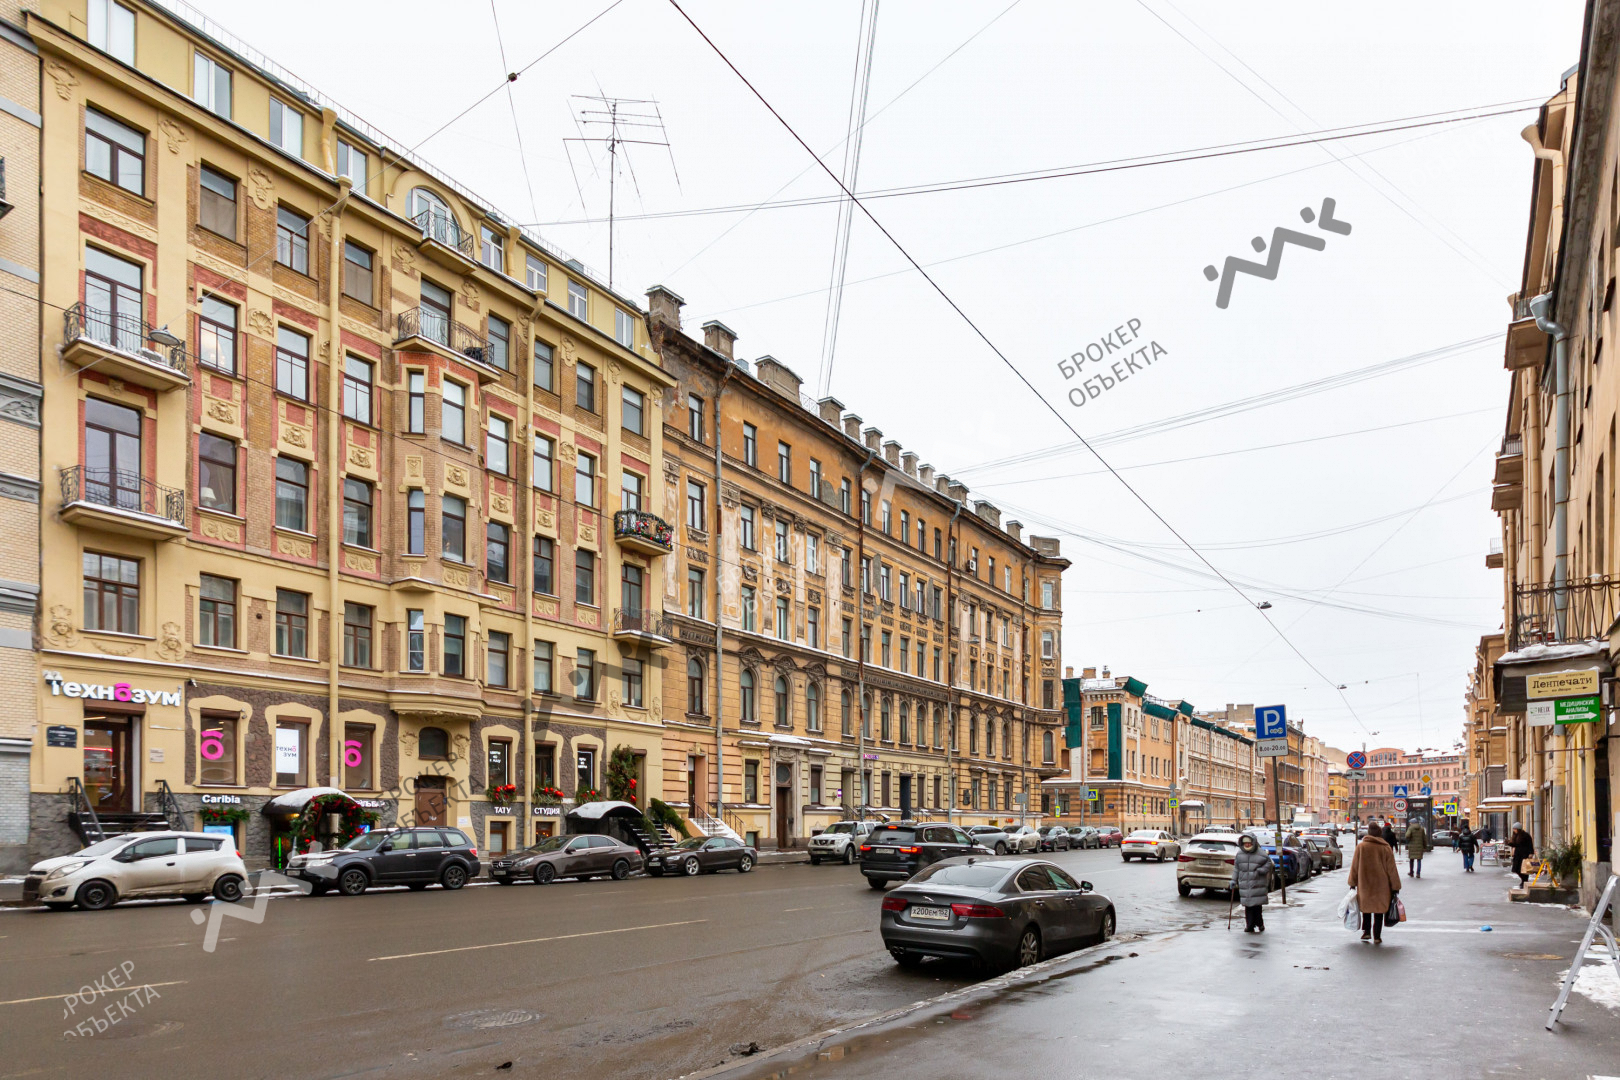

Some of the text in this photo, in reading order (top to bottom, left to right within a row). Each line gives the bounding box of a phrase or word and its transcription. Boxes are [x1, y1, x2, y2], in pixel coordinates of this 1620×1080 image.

[1532, 677, 1592, 689] Ленпечати
[1263, 709, 1280, 735] P
[201, 794, 240, 804] Caribia
[494, 806, 511, 814] ТАТУ
[534, 807, 560, 816] СТУДИЯ
